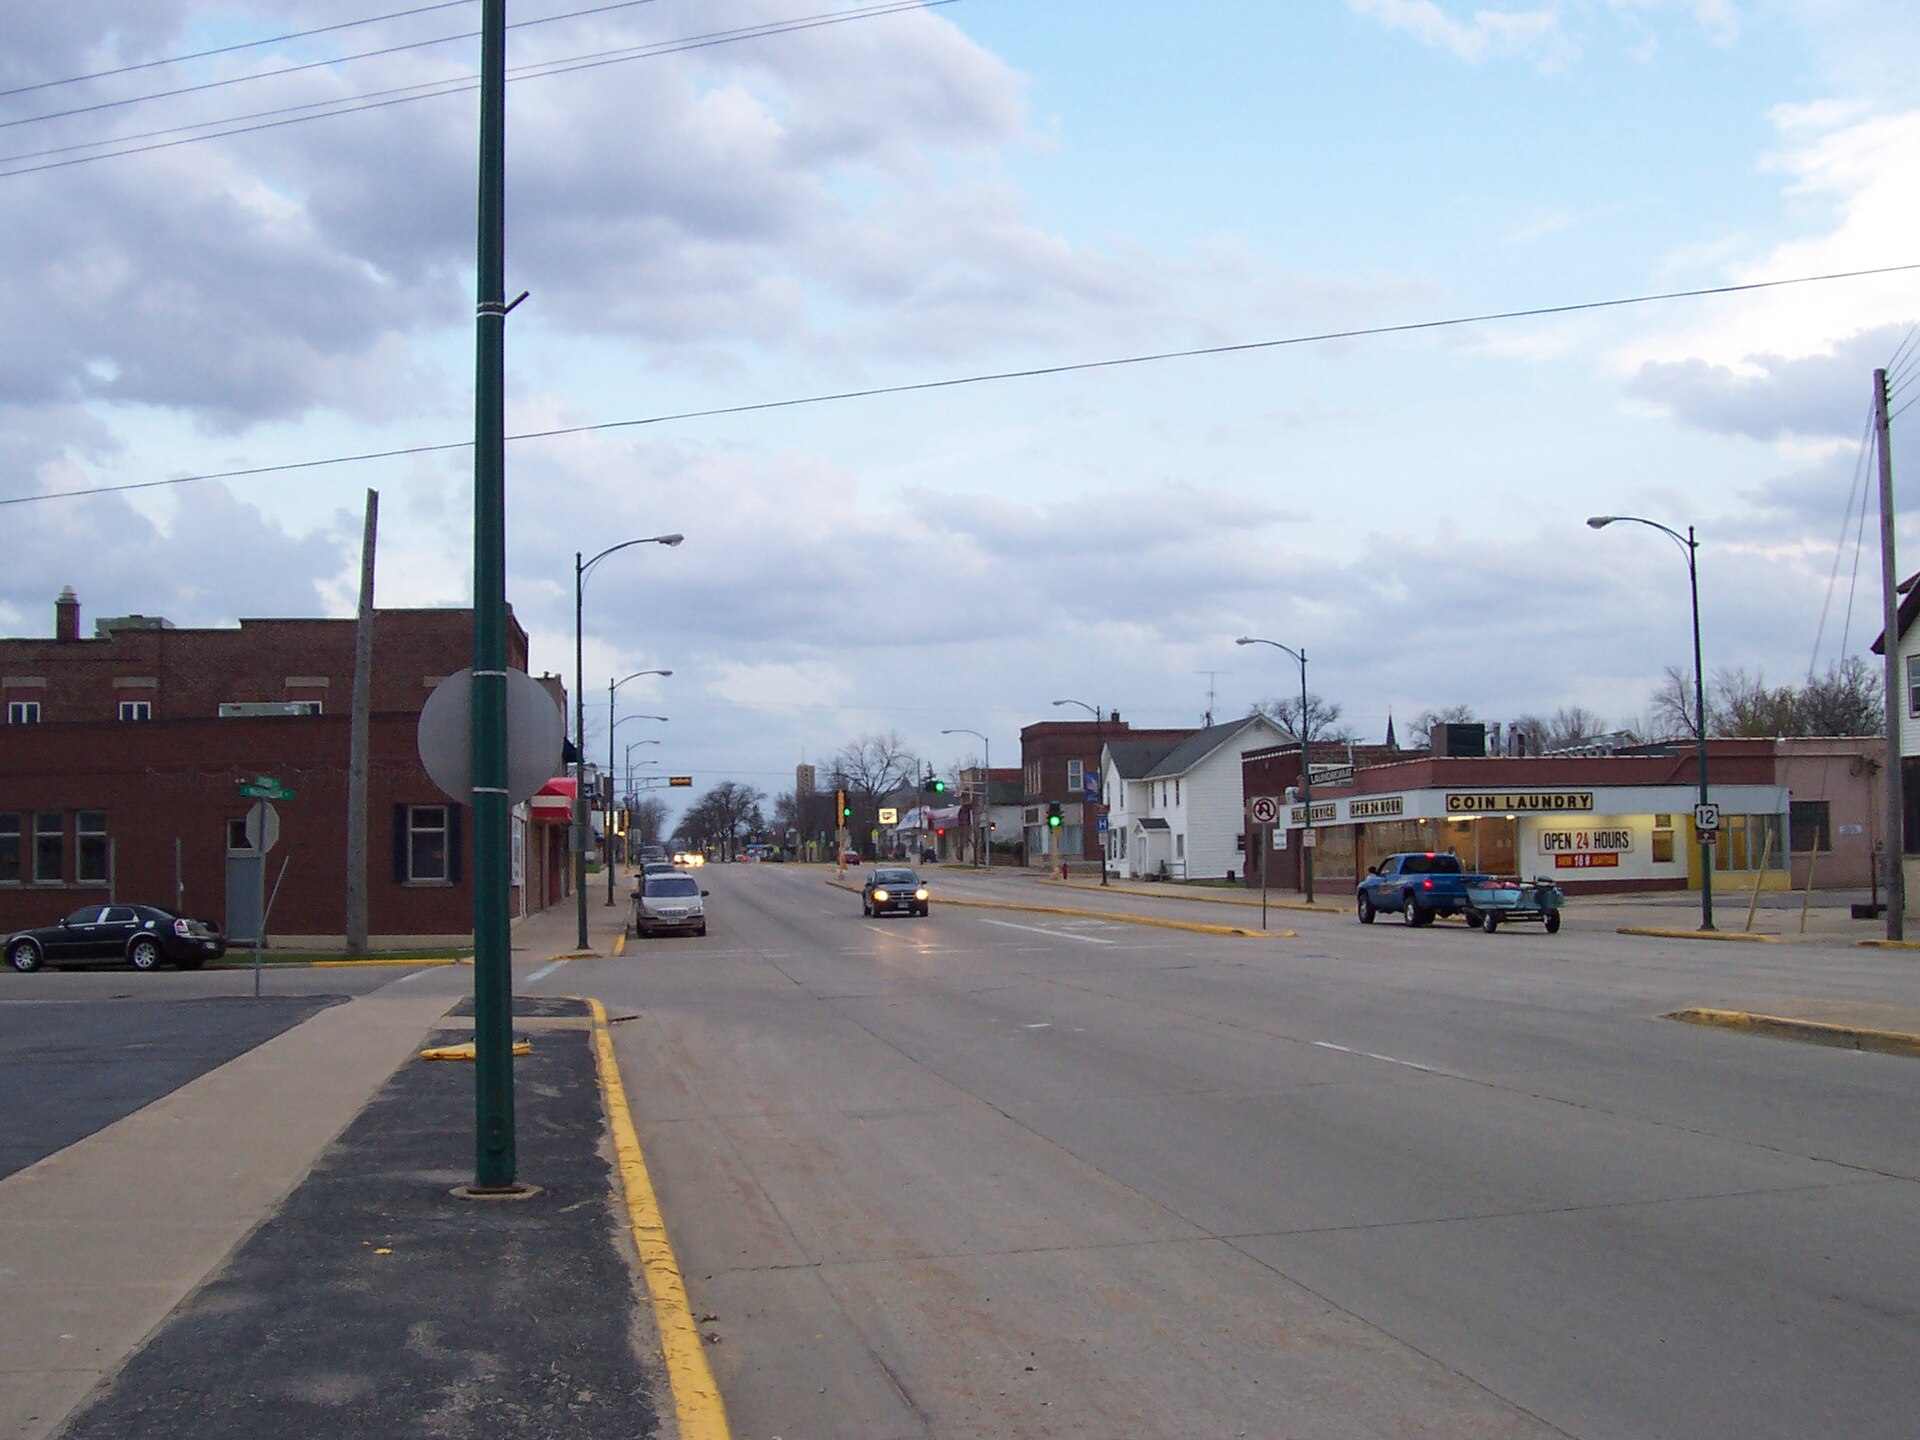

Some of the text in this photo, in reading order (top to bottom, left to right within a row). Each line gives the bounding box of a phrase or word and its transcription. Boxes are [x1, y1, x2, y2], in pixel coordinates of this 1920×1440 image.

[1351, 802, 1369, 815] OPEN
[1371, 801, 1379, 814] 24
[1449, 795, 1590, 809] COIN LAUNDRY
[1098, 818, 1107, 829] H
[1700, 809, 1714, 824] 12
[1544, 831, 1629, 850] OPEN 24 HOURS
